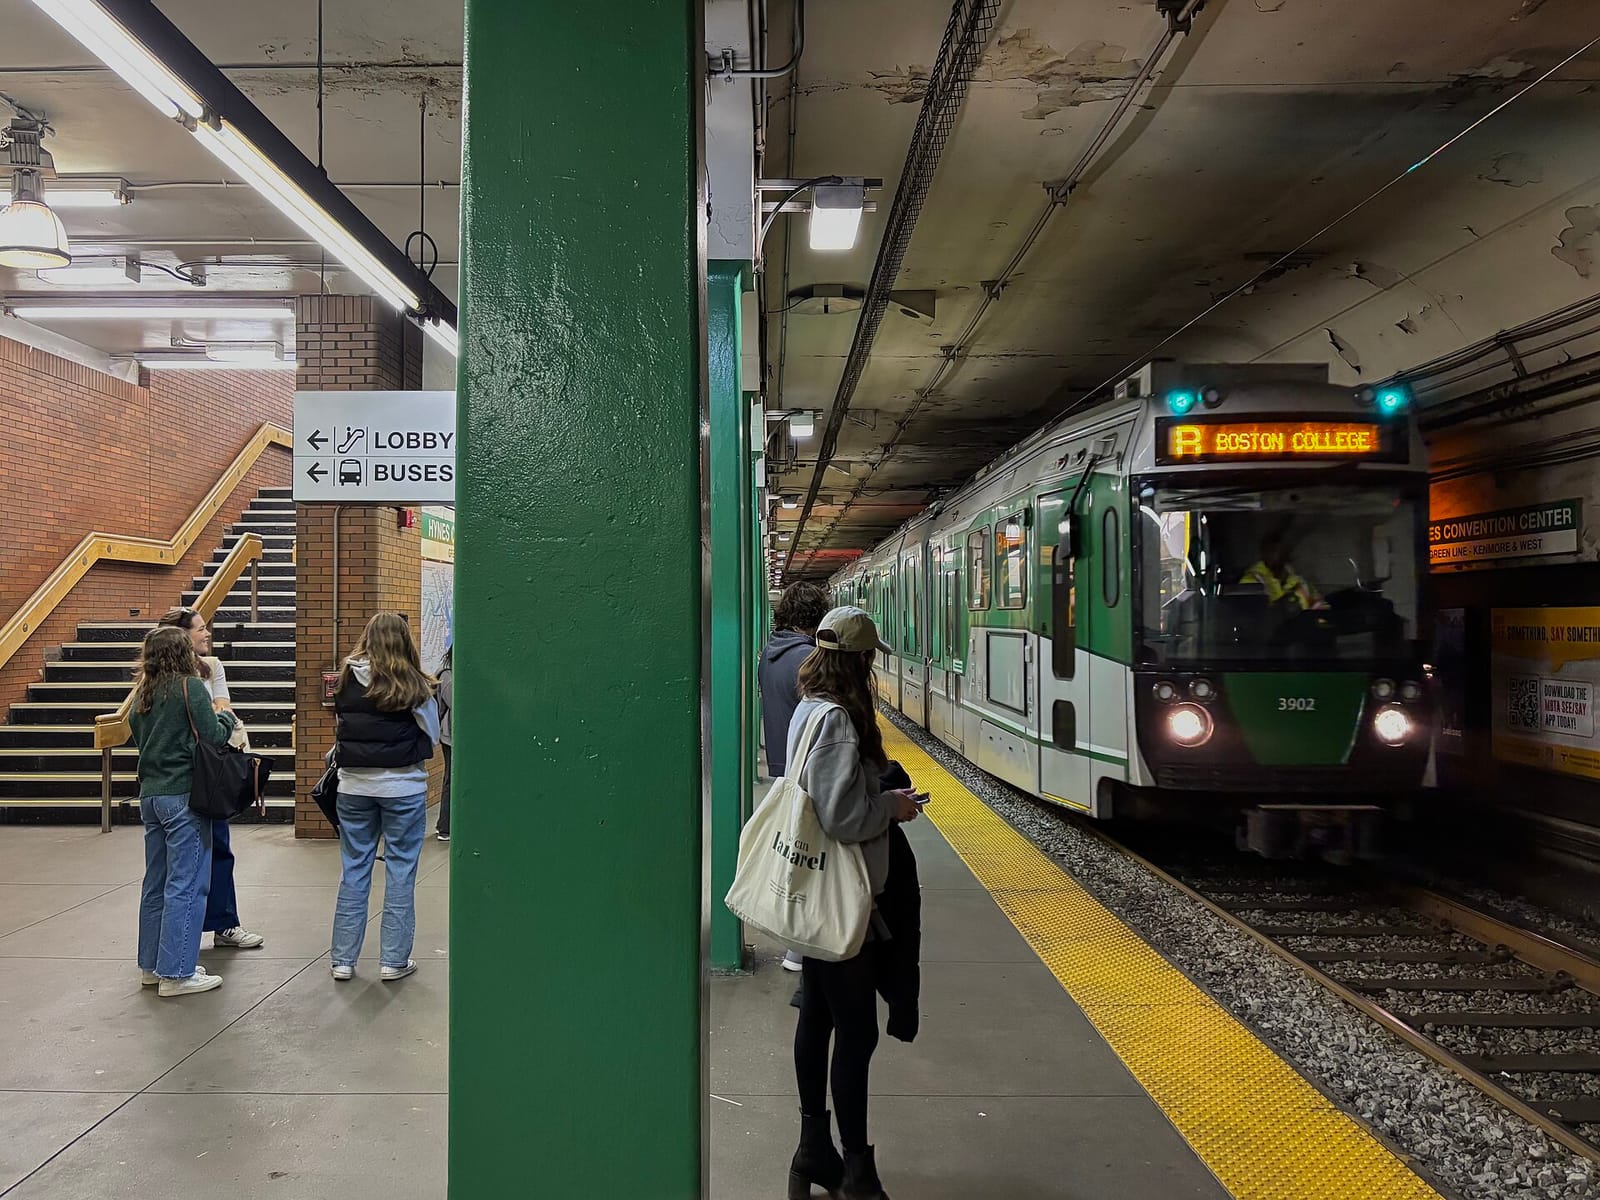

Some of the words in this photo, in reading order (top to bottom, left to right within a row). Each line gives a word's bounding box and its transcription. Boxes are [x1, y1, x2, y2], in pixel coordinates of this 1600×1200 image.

[374, 431, 454, 450] LOBBY
[1216, 433, 1284, 451] BOSTON
[1292, 431, 1371, 450] COLLEGE
[374, 464, 453, 482] BUSES
[428, 519, 450, 542] HYNES
[1443, 518, 1516, 538] CONVENTION
[1519, 507, 1572, 529] CENTER
[1452, 547, 1467, 557] LINE
[1473, 543, 1511, 555] KENMORE
[1519, 538, 1543, 550] WEST
[1550, 626, 1565, 642] SAY
[1544, 684, 1575, 699] DOWNLOAD
[1576, 687, 1587, 700] THE
[1278, 698, 1316, 711] 3902
[1544, 699, 1560, 713] MBTA
[1561, 700, 1587, 716] SEE/SAY
[1545, 713, 1556, 727] APP
[1557, 715, 1577, 730] TODAY!
